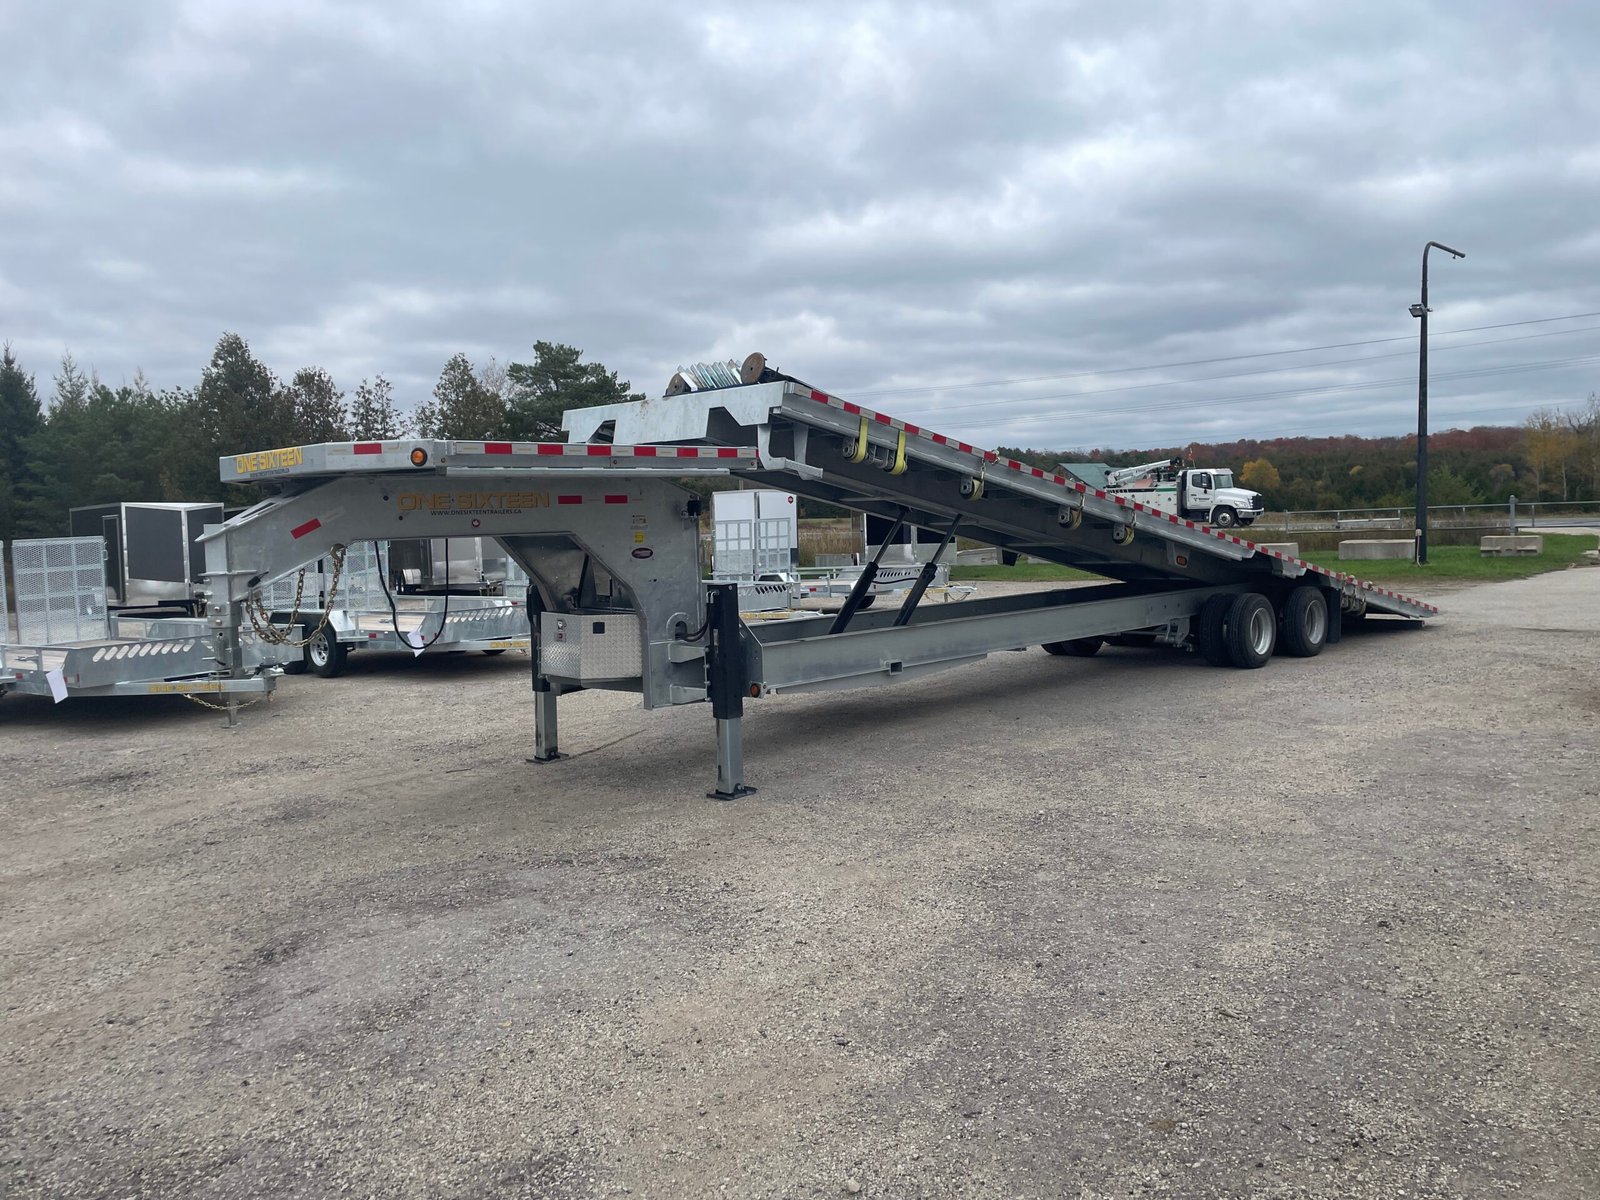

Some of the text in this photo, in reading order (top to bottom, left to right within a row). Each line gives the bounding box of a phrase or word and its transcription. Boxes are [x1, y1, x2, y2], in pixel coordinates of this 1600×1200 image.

[236, 455, 257, 473] ONE
[259, 447, 303, 470] SIXTEEN
[397, 491, 549, 510] ONE SIXTEEN
